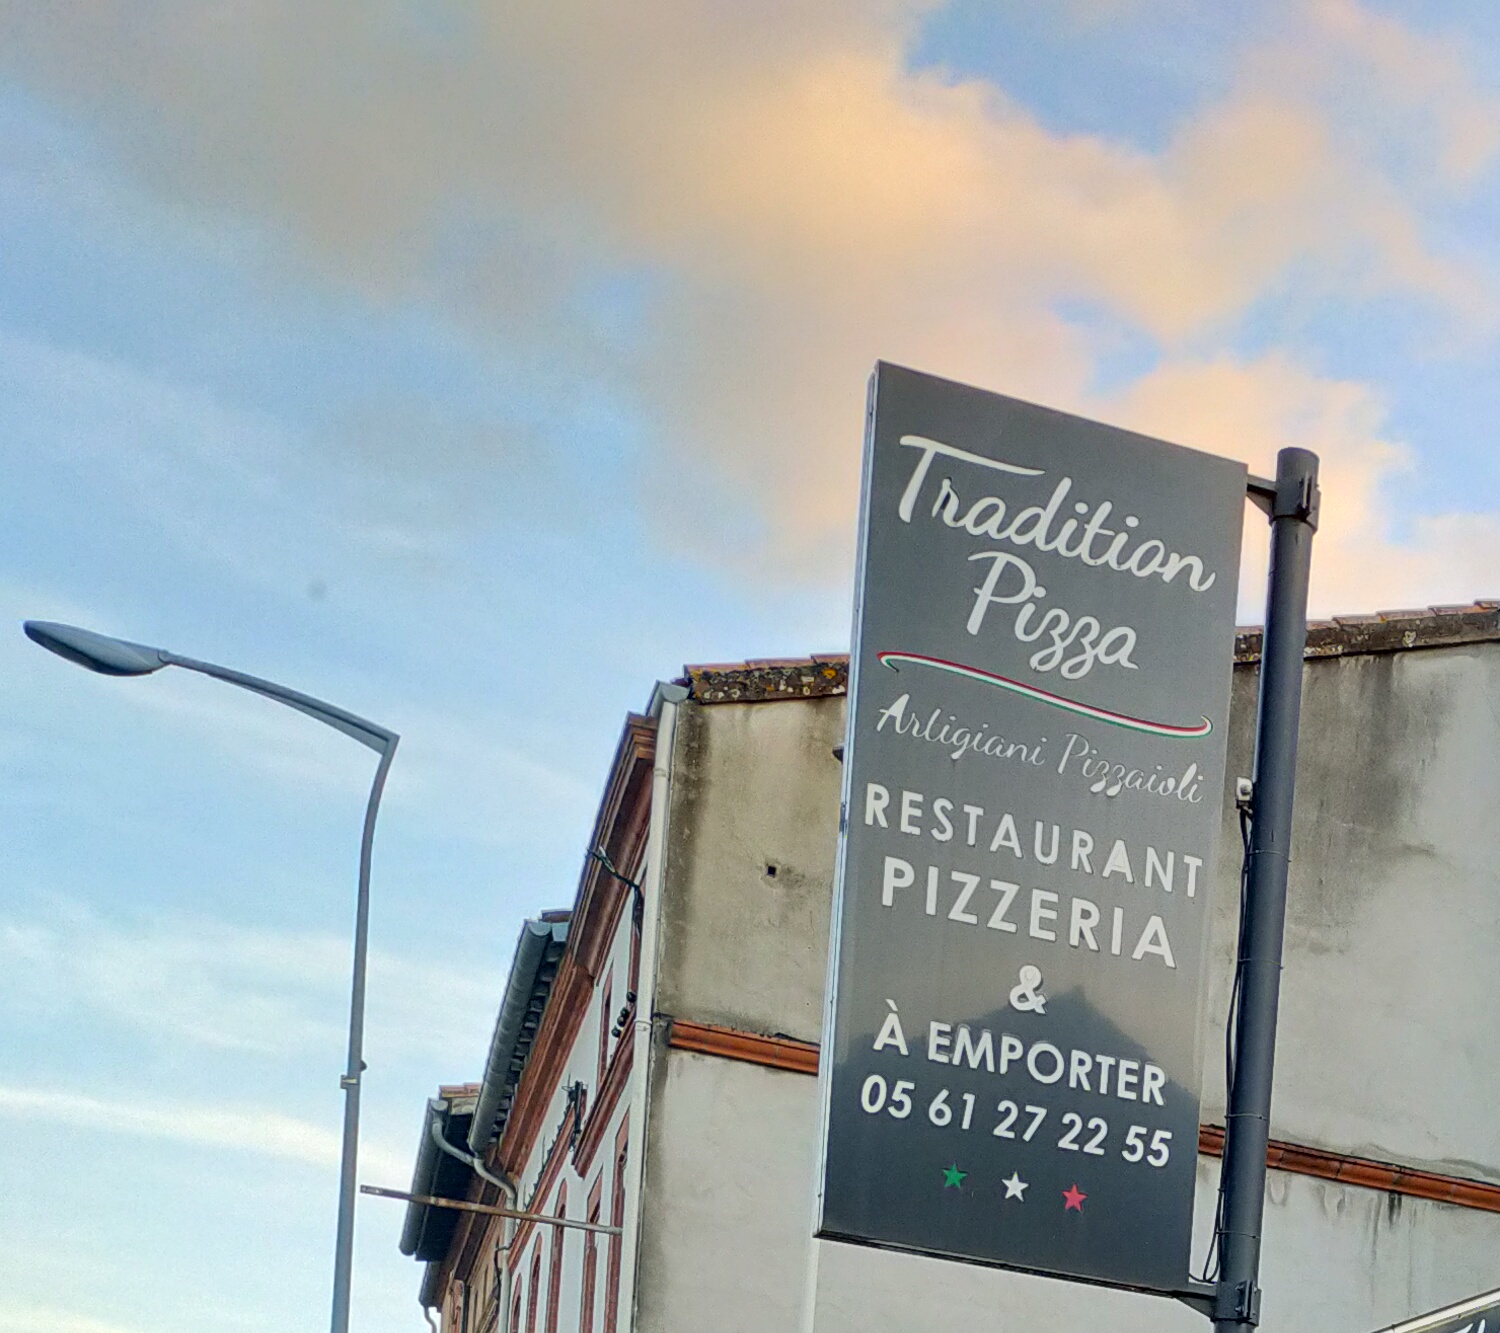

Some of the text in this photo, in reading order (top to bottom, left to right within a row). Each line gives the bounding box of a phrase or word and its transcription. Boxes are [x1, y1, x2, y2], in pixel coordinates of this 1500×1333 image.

[898, 434, 1214, 594] Tradition
[966, 550, 1139, 680] Pizza
[876, 693, 1203, 804] Artigiani Pizzaioli
[865, 783, 1203, 899] RESTAURANT
[882, 856, 1177, 968] PIZZERIA
[1009, 964, 1045, 1014] &
[873, 1000, 1167, 1107] À EMPORTER
[861, 1074, 1171, 1167] 05 61 27 22 55
